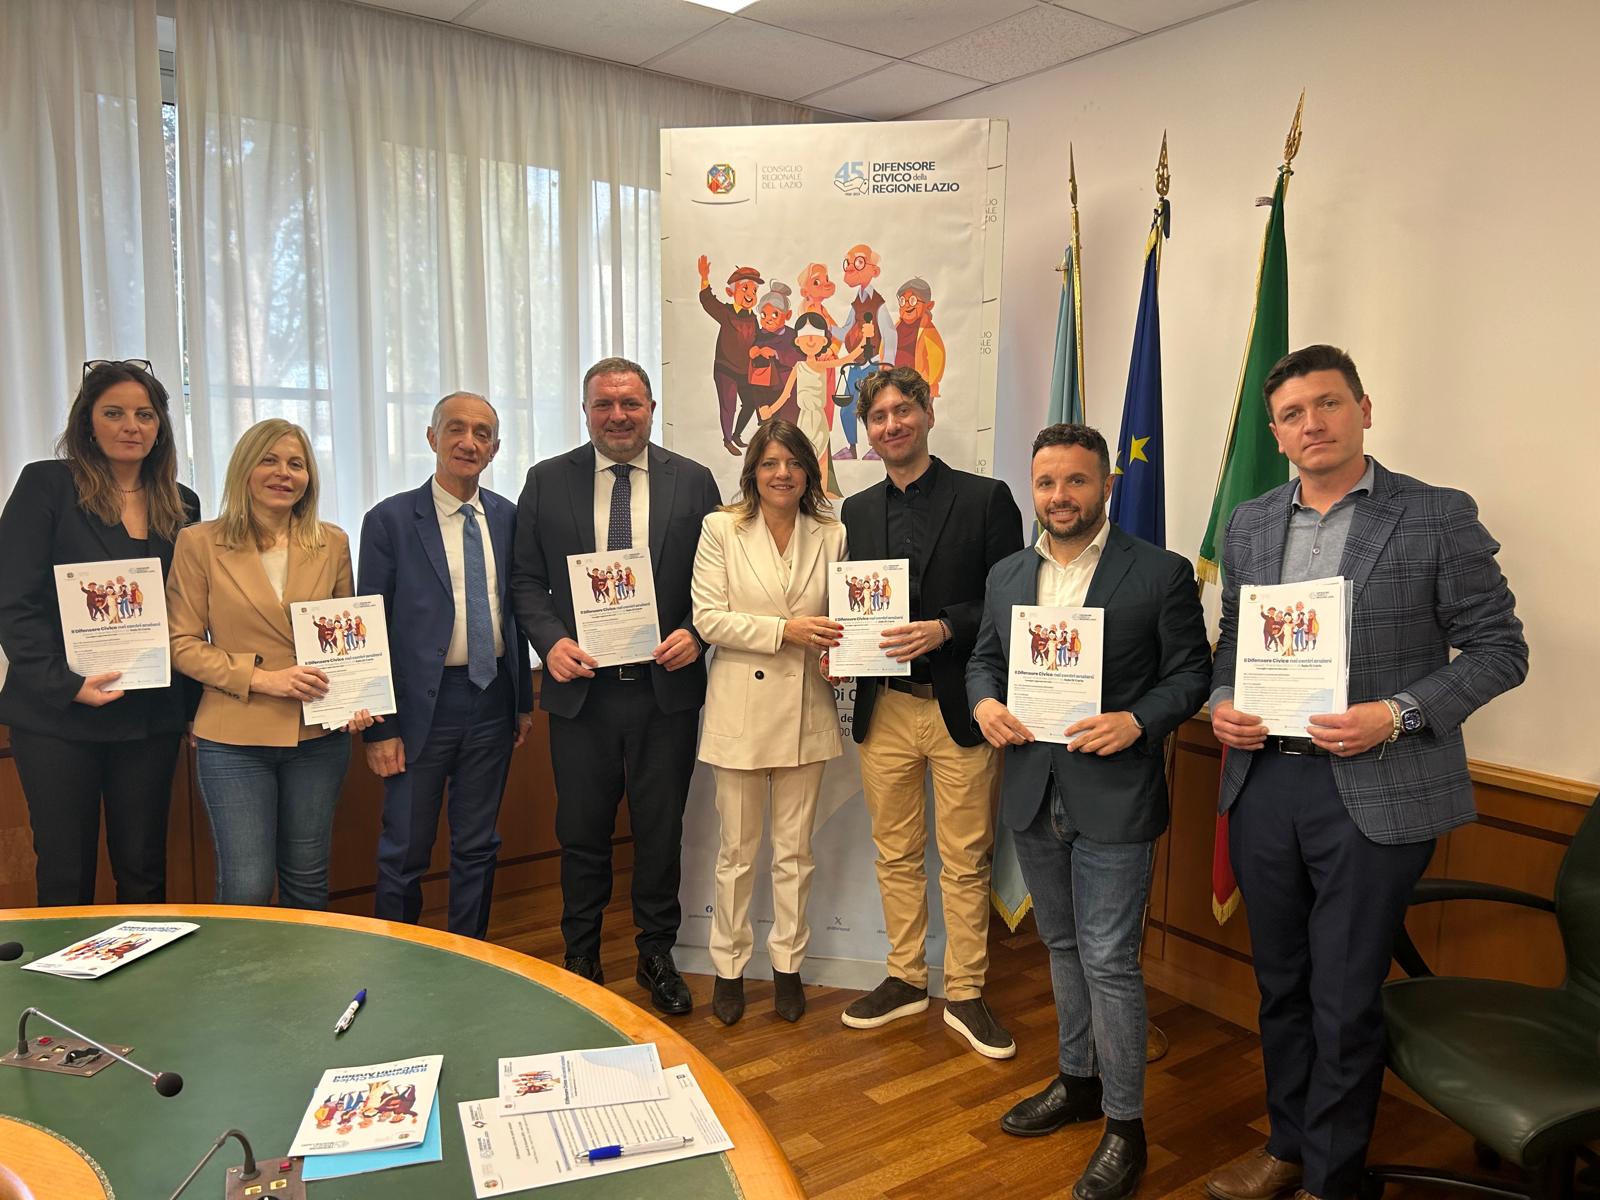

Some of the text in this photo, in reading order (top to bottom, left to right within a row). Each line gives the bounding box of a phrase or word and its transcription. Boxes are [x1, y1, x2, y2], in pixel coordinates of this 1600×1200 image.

[762, 164, 803, 173] CONSIGLIO
[873, 161, 936, 172] DIFENSORE
[872, 173, 912, 182] CIVICO
[762, 181, 803, 190] DEL LAZIO
[872, 184, 922, 194] REGIONE
[924, 182, 960, 192] LAZIO
